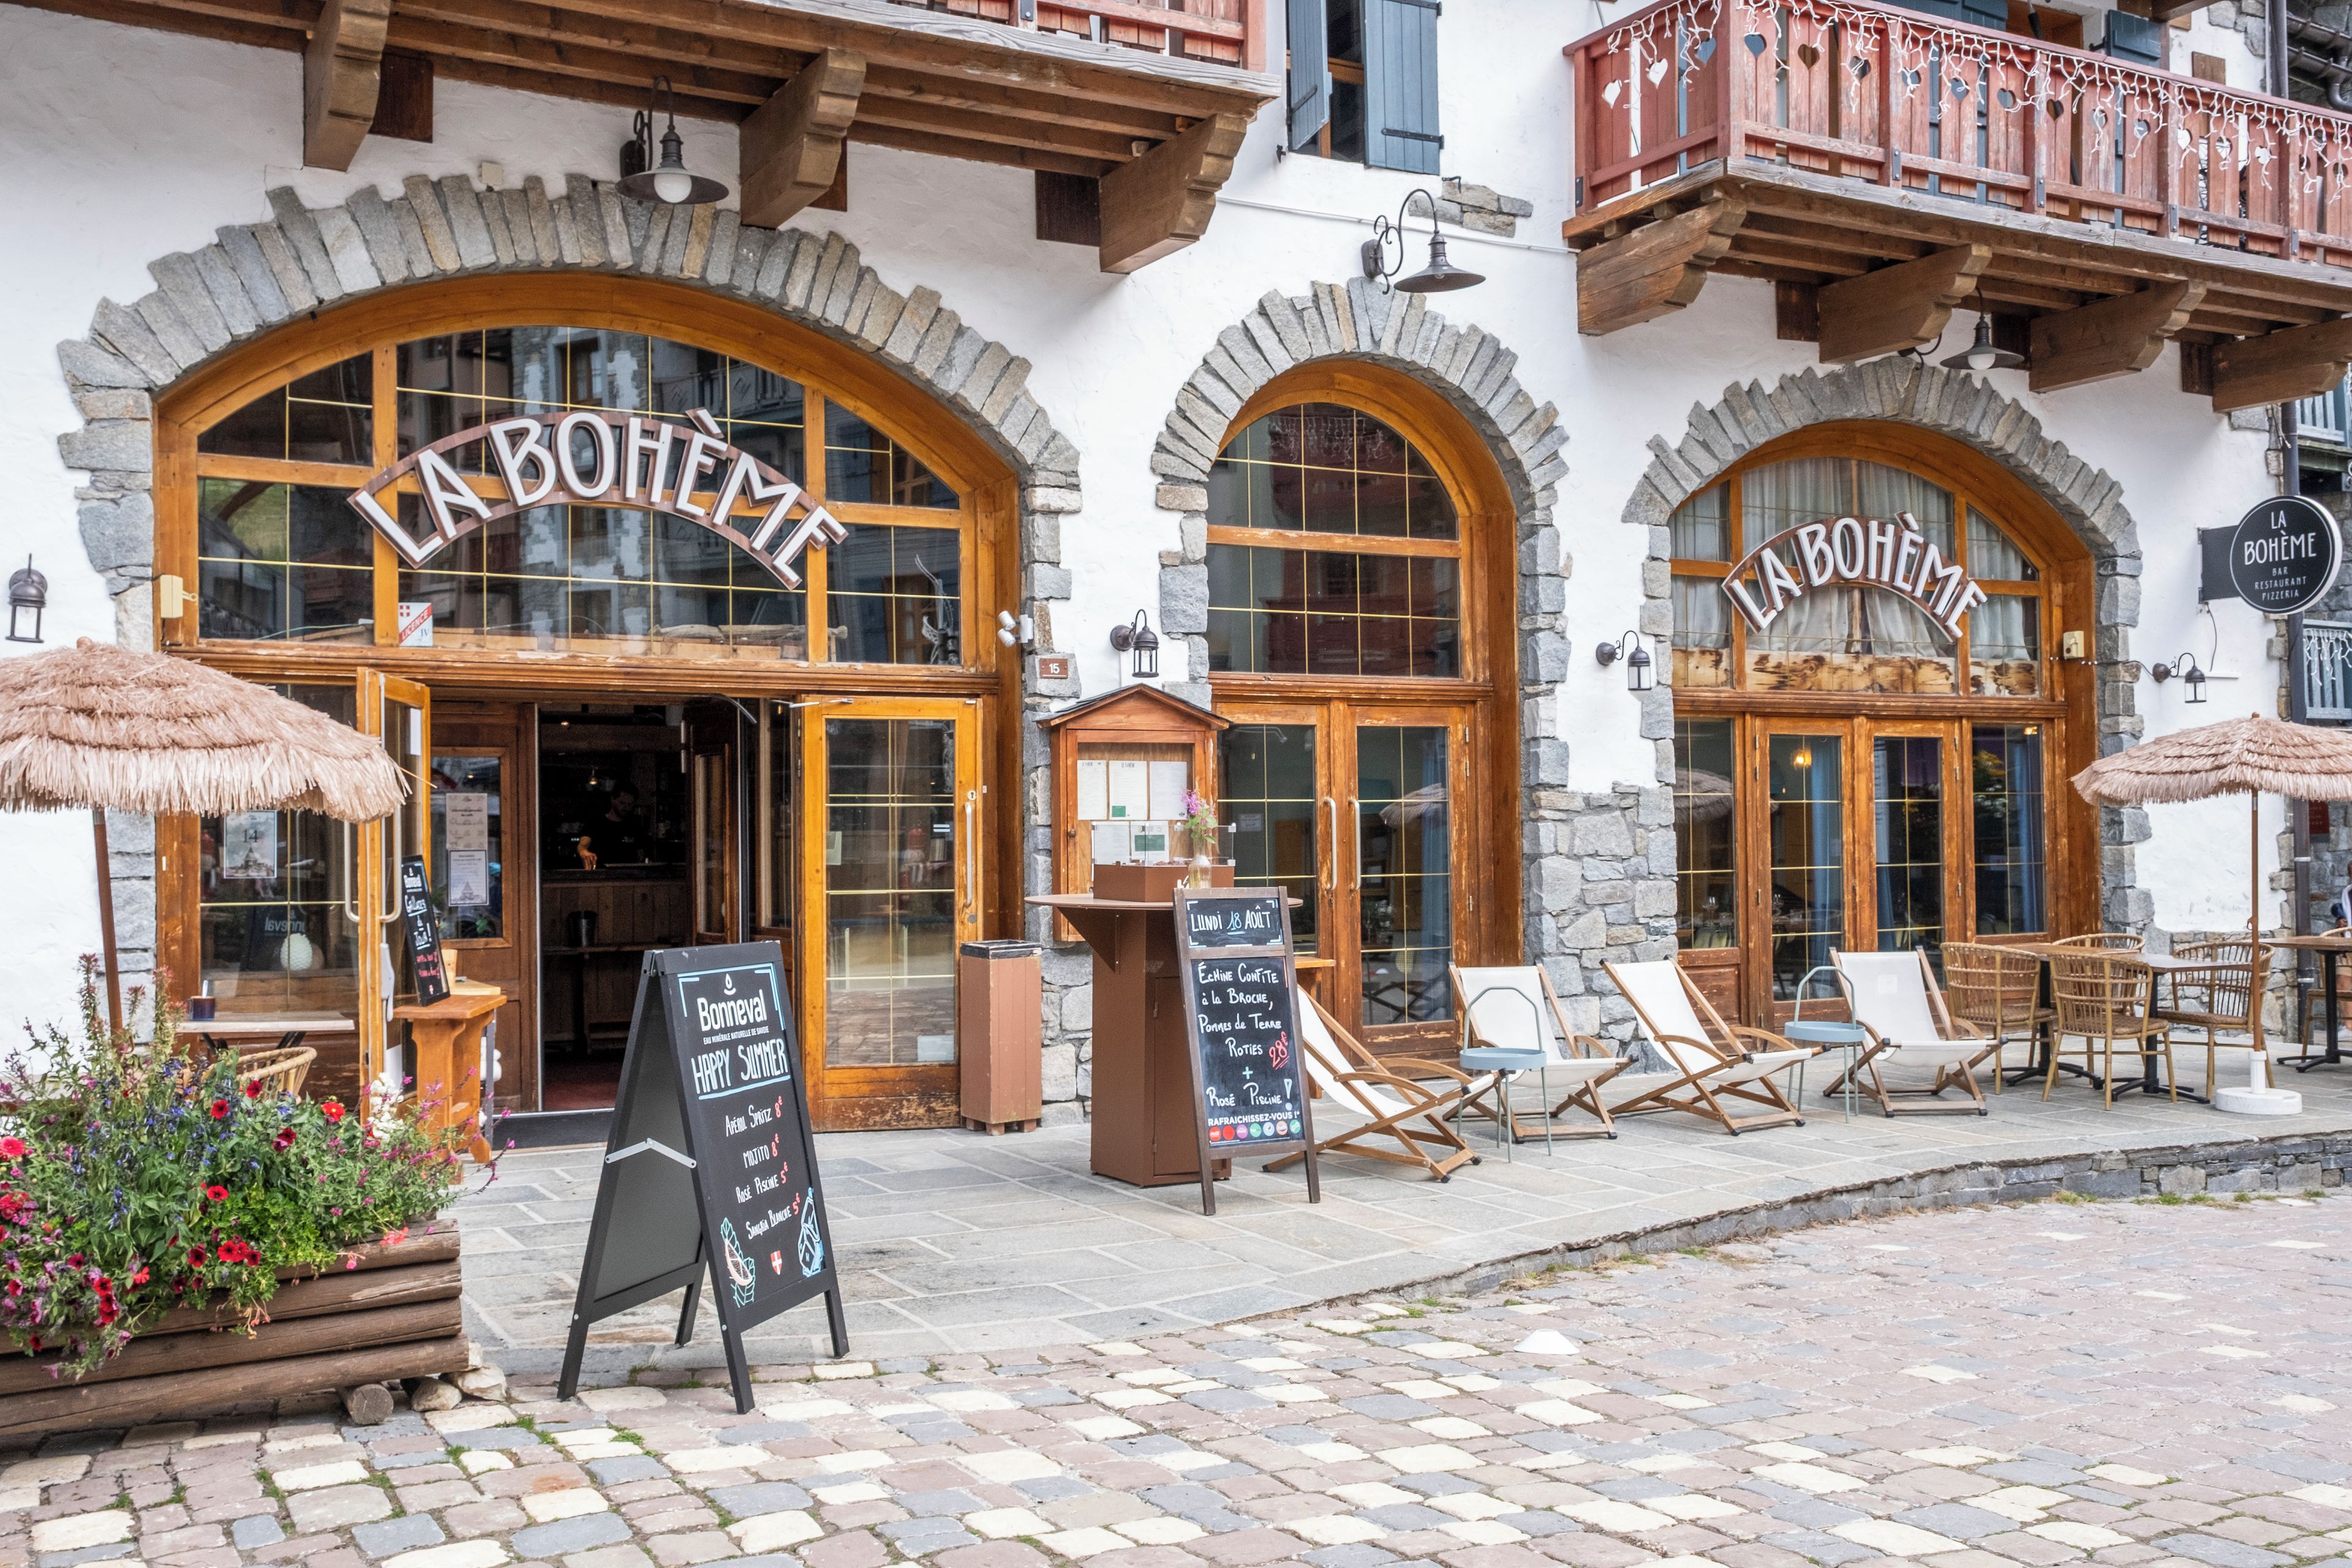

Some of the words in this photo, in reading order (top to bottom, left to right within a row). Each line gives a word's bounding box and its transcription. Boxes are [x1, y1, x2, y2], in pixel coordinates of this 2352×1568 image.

[355, 449, 492, 562] LA
[490, 409, 848, 586] BOHÈME
[2271, 510, 2286, 529] LA
[2244, 529, 2316, 565] BOHÈME
[1730, 548, 1802, 629] LA
[1796, 512, 1988, 638] BOHÈME
[2272, 567, 2288, 576] BAR
[2255, 576, 2307, 590] RESTAURANT
[2262, 589, 2299, 601] PIZZERIA
[402, 609, 429, 641] LICENCE
[1049, 663, 1060, 674] 15
[243, 829, 258, 843] 14
[1226, 911, 1242, 930] 18
[1245, 905, 1271, 930] AOÛT
[1211, 990, 1223, 1005] la
[696, 989, 767, 1031] Bonneval
[1235, 1012, 1247, 1030] de
[703, 1036, 712, 1045] EAU
[712, 1033, 731, 1043] MINÉRALE
[731, 1029, 752, 1039] NATURELLE
[756, 1025, 769, 1035] SAVOIE
[691, 1048, 731, 1094] HAPPY
[737, 1038, 788, 1080] SUMMER
[1208, 1112, 1293, 1126] RAFRAICHISSEZ-VOUS
